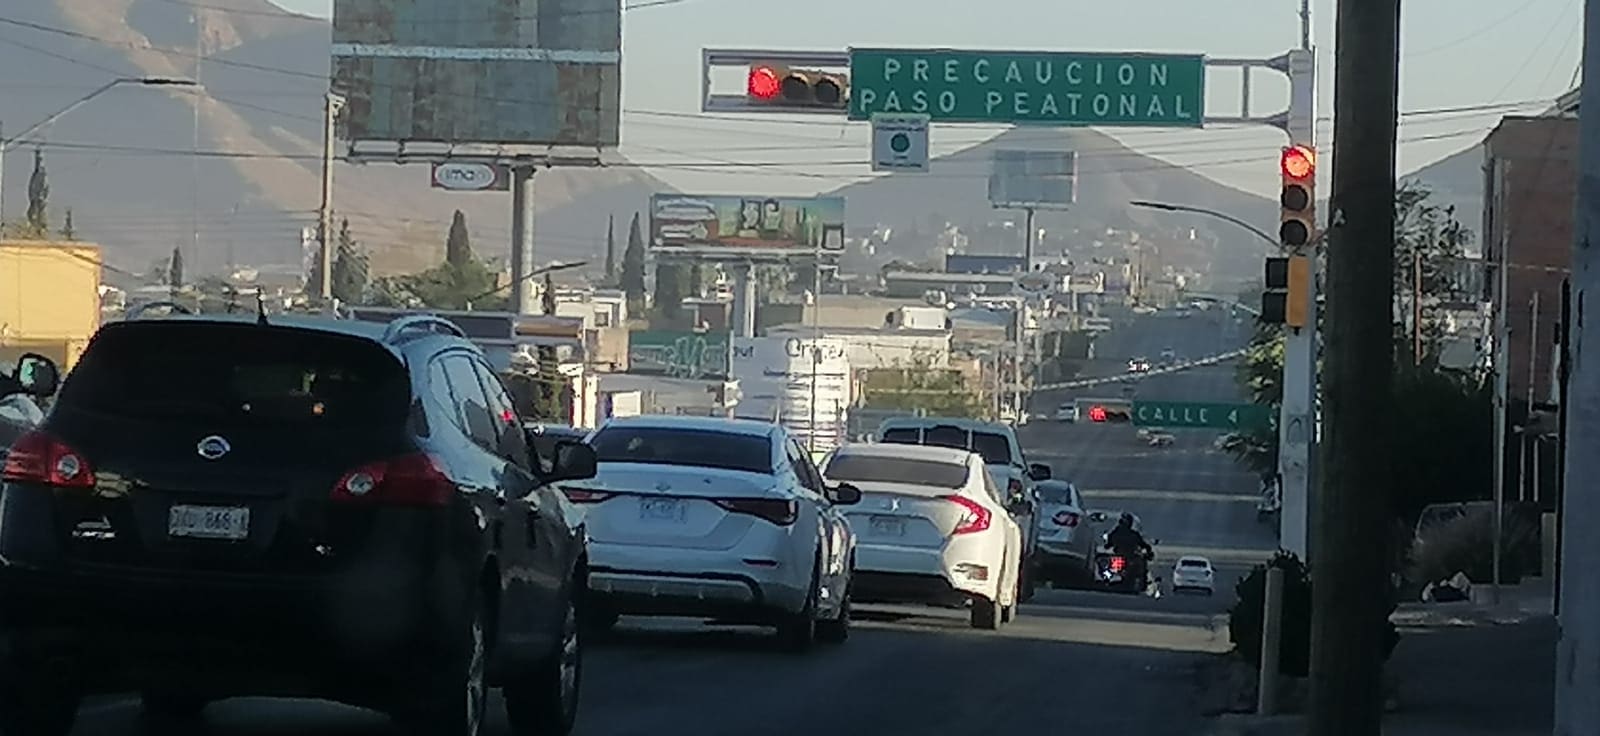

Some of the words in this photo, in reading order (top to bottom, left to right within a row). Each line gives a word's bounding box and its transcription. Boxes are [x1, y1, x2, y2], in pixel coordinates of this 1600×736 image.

[884, 58, 1168, 86] PRECAUCION
[859, 89, 956, 113] PASO
[986, 91, 1192, 119] PEATONAL
[1138, 406, 1208, 423] CALLE
[1228, 409, 1237, 423] 4
